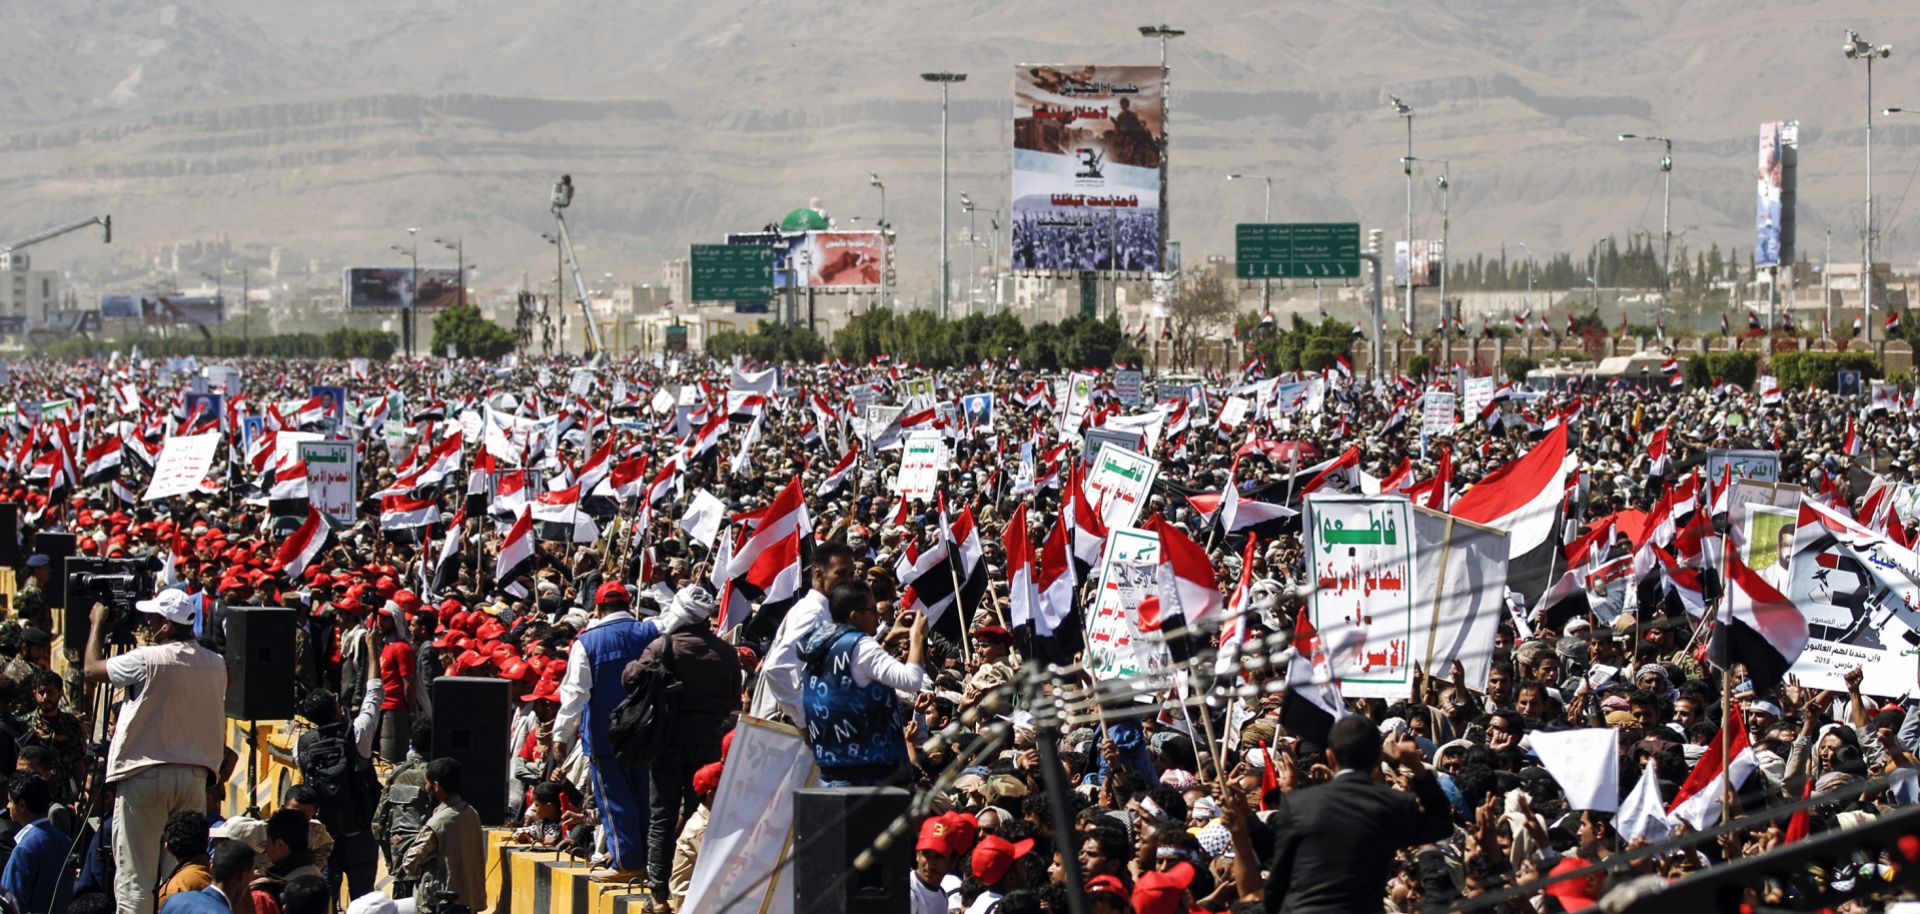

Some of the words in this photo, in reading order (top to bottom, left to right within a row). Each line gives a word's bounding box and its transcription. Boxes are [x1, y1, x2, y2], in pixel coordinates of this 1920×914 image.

[1101, 452, 1146, 482] قاطعوا
[1750, 461, 1773, 477] الله
[1317, 509, 1397, 554] قاطعوا
[1317, 557, 1360, 597] الأمريكية
[1364, 562, 1406, 598] البضائع
[1814, 656, 1831, 665] 2018
